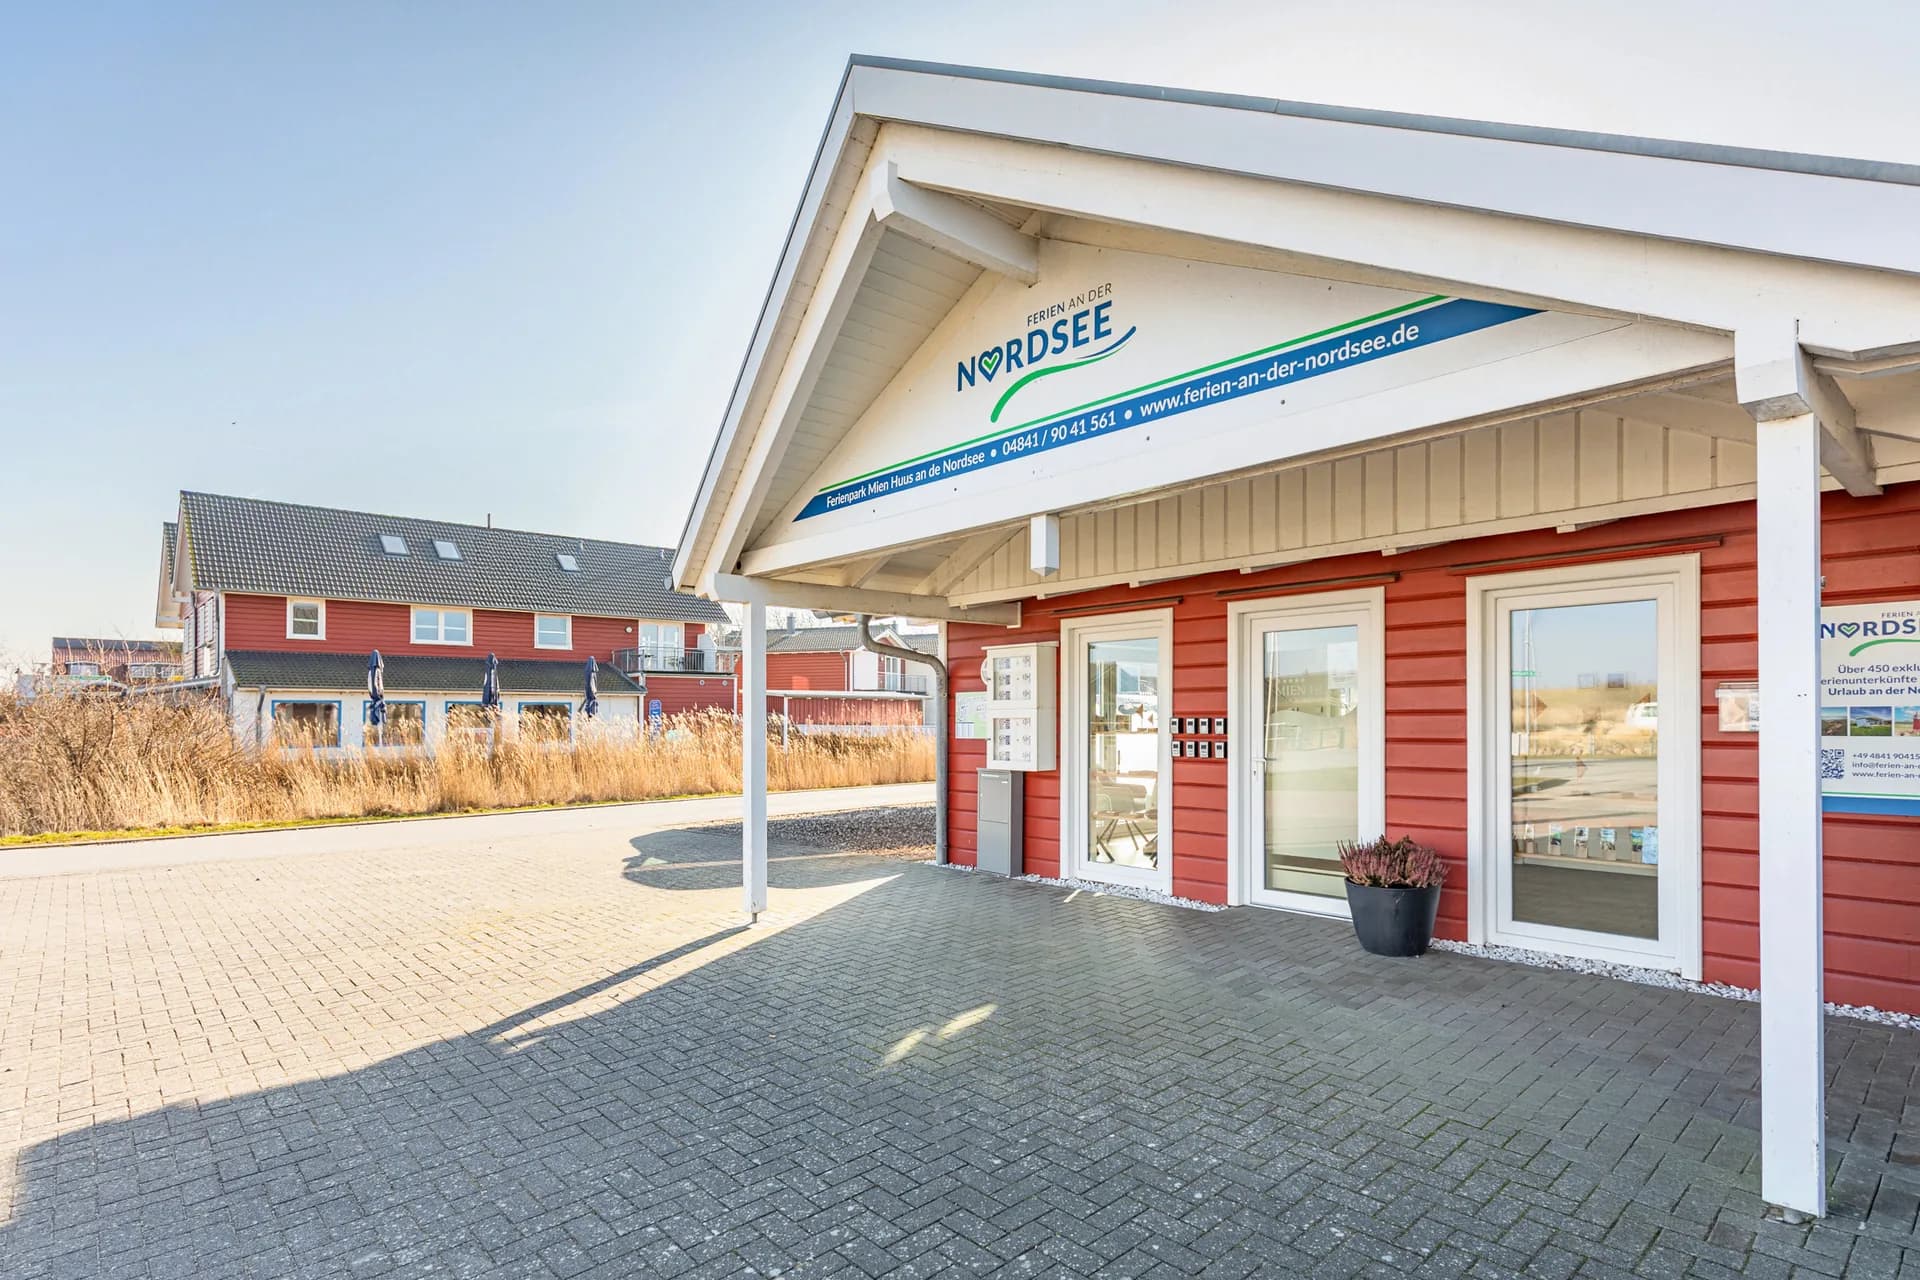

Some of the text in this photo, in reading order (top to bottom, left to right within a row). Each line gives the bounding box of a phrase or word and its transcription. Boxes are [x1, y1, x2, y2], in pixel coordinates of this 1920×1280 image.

[1027, 282, 1112, 327] FERIEN AN DER
[957, 300, 1112, 392] NORDSEE
[826, 323, 1419, 508] Ferienpark Mien Huus an de Nordsee 04841 / 90 41 561 www.ferien-an-der-nordsee.de
[1881, 611, 1913, 619] FERIEN
[1820, 618, 1920, 639] NORDS
[1838, 664, 1865, 674] Über
[1867, 664, 1890, 673] 450
[1820, 675, 1918, 685] erienunterkünfte
[1828, 687, 1867, 696] Urlaub
[1885, 686, 1905, 695] der
